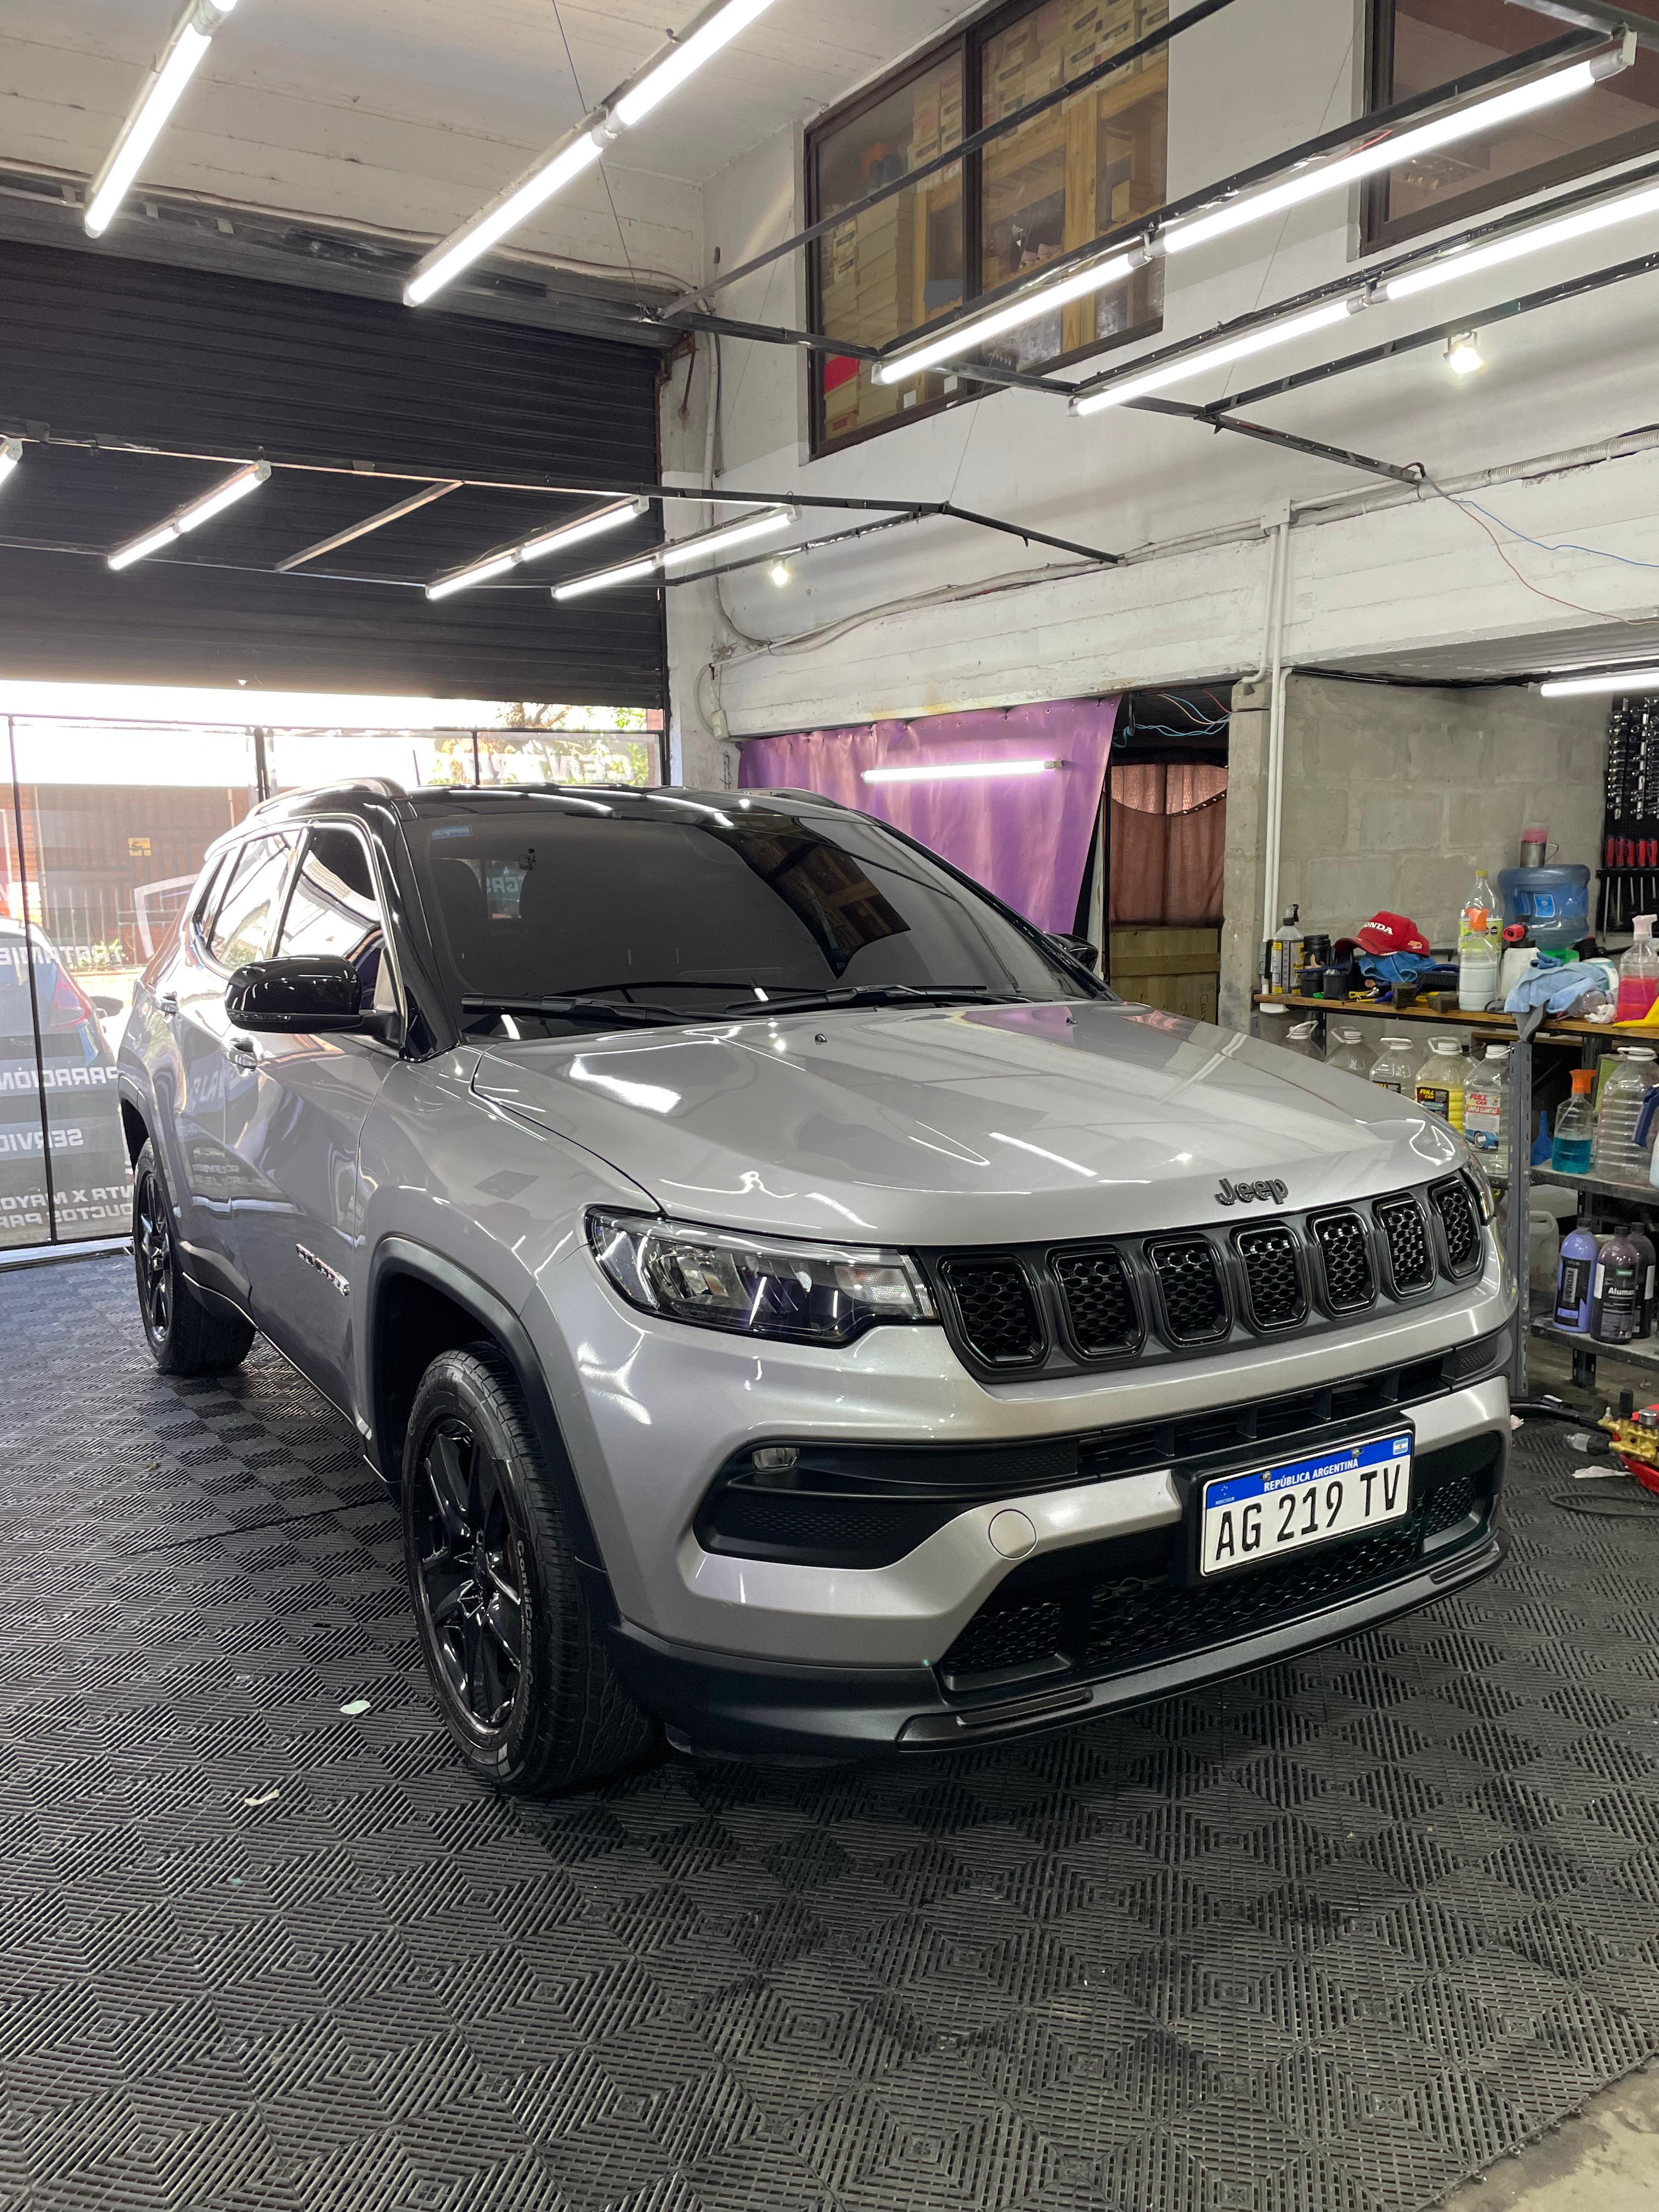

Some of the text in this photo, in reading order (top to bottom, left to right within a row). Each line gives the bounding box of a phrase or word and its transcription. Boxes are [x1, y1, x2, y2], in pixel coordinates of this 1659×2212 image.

[1214, 1178, 1289, 1206] Jeep
[1263, 1458, 1359, 1493] REPÚBLICA ARGENTINA
[1216, 1464, 1401, 1561] AG 219 TV
